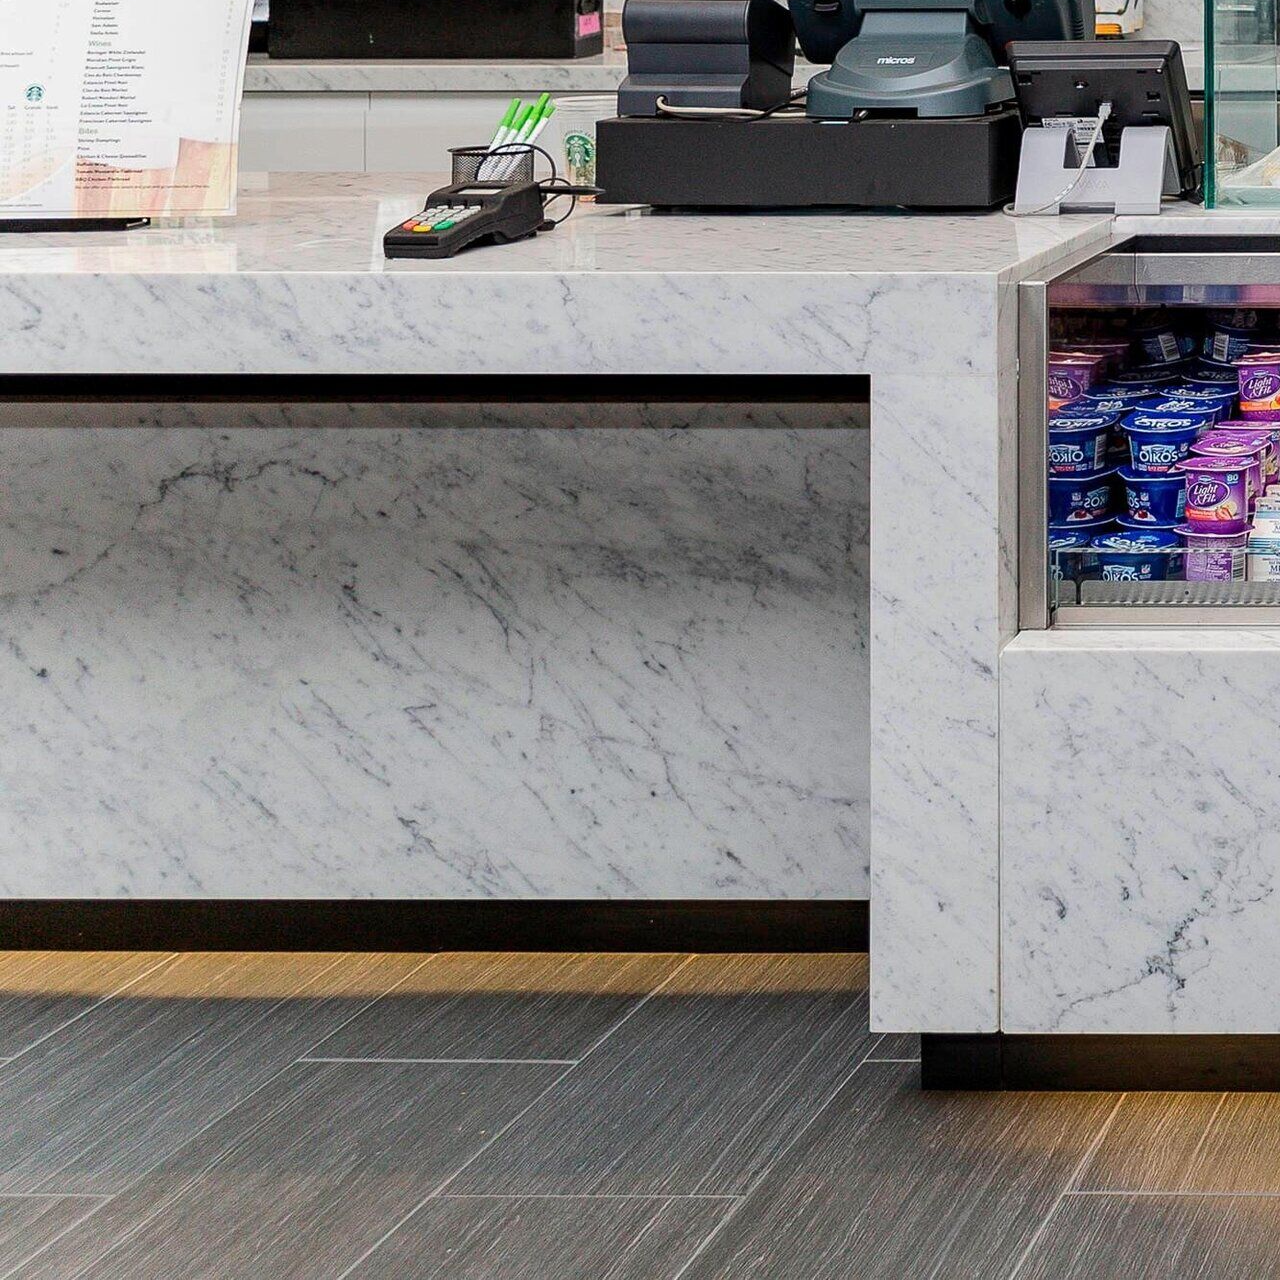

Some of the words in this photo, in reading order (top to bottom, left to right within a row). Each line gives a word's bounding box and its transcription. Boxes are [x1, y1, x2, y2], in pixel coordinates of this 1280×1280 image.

[876, 56, 916, 65] micros
[1248, 377, 1273, 390] Light
[1139, 448, 1179, 463] OIKOS
[1226, 473, 1239, 482] 80
[1193, 484, 1219, 496] Light
